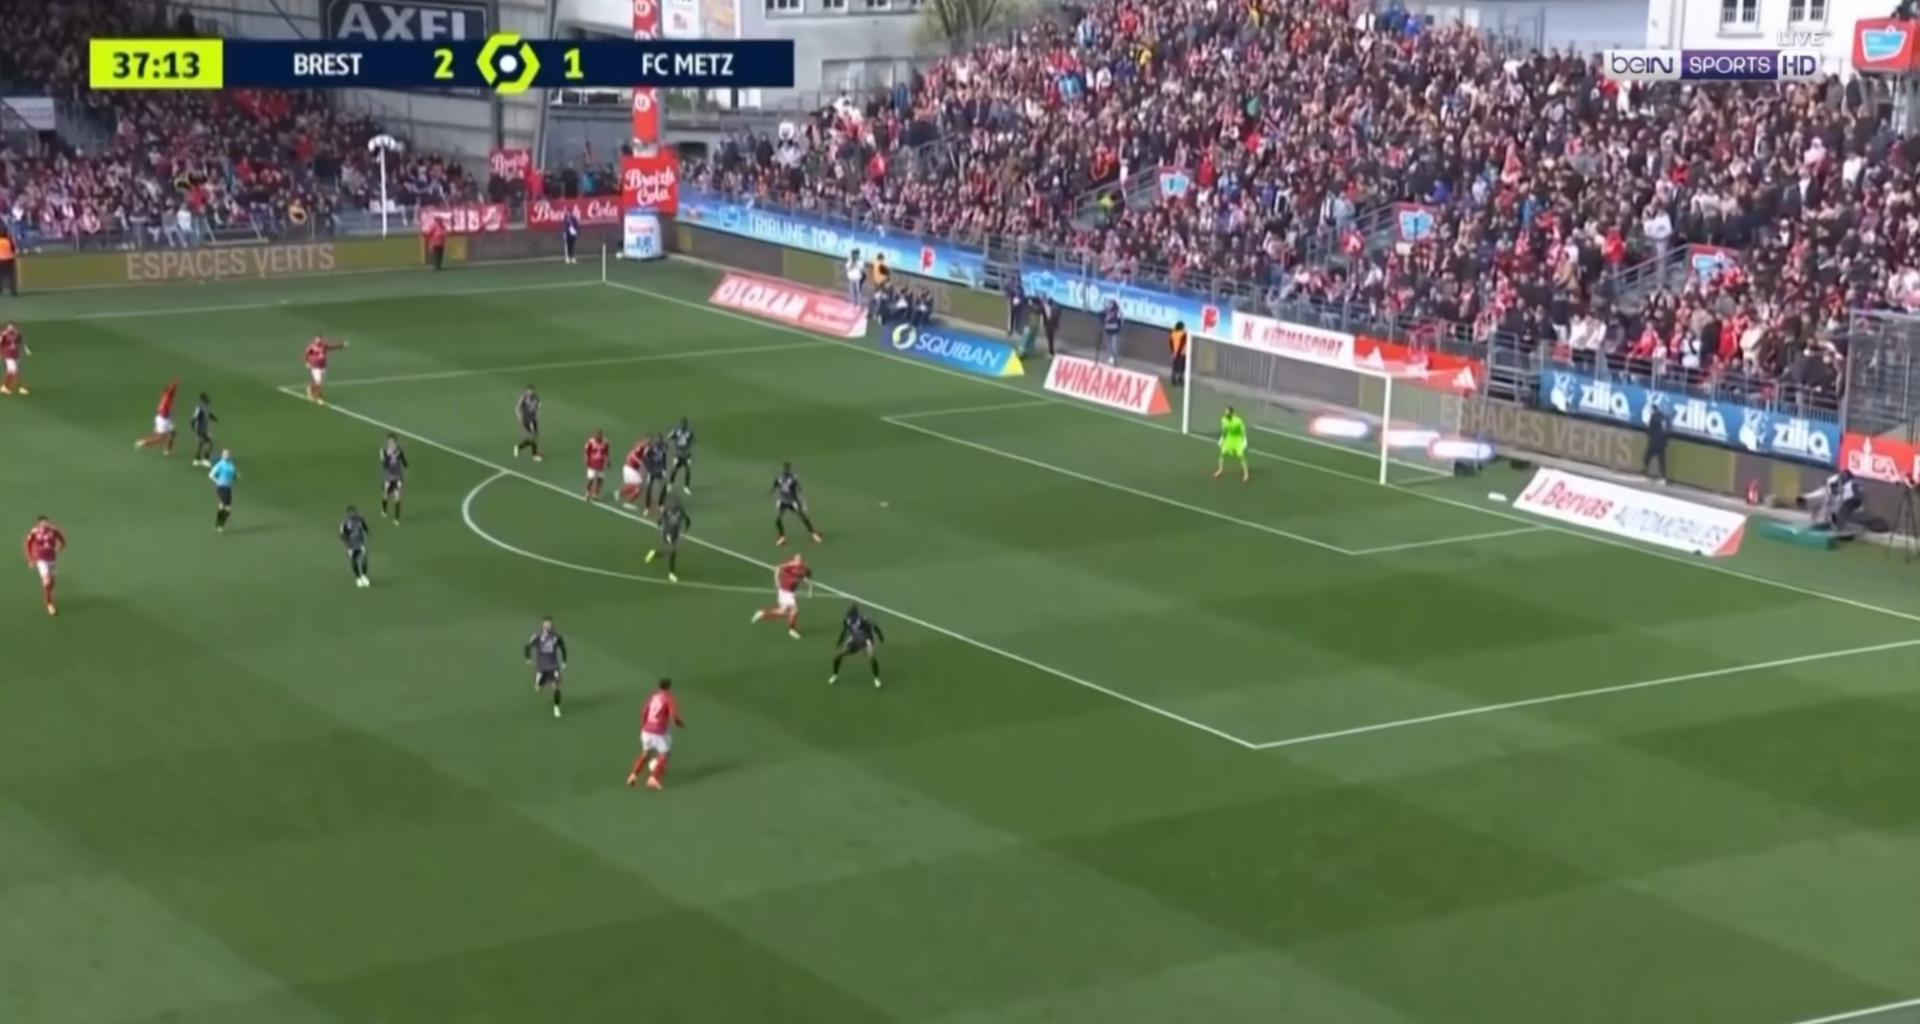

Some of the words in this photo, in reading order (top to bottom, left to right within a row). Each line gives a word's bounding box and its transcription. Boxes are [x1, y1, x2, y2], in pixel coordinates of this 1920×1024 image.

[623, 165, 676, 191] Breizh
[637, 181, 672, 206] Cola
[586, 200, 619, 220] Cola
[748, 213, 808, 245] TRIBUNE
[126, 250, 246, 281] ESPACES
[253, 243, 335, 278] VERTS
[916, 332, 1001, 369] SQUIBAN
[1053, 357, 1149, 409] WINAMAX
[1551, 415, 1634, 466] VERTS
